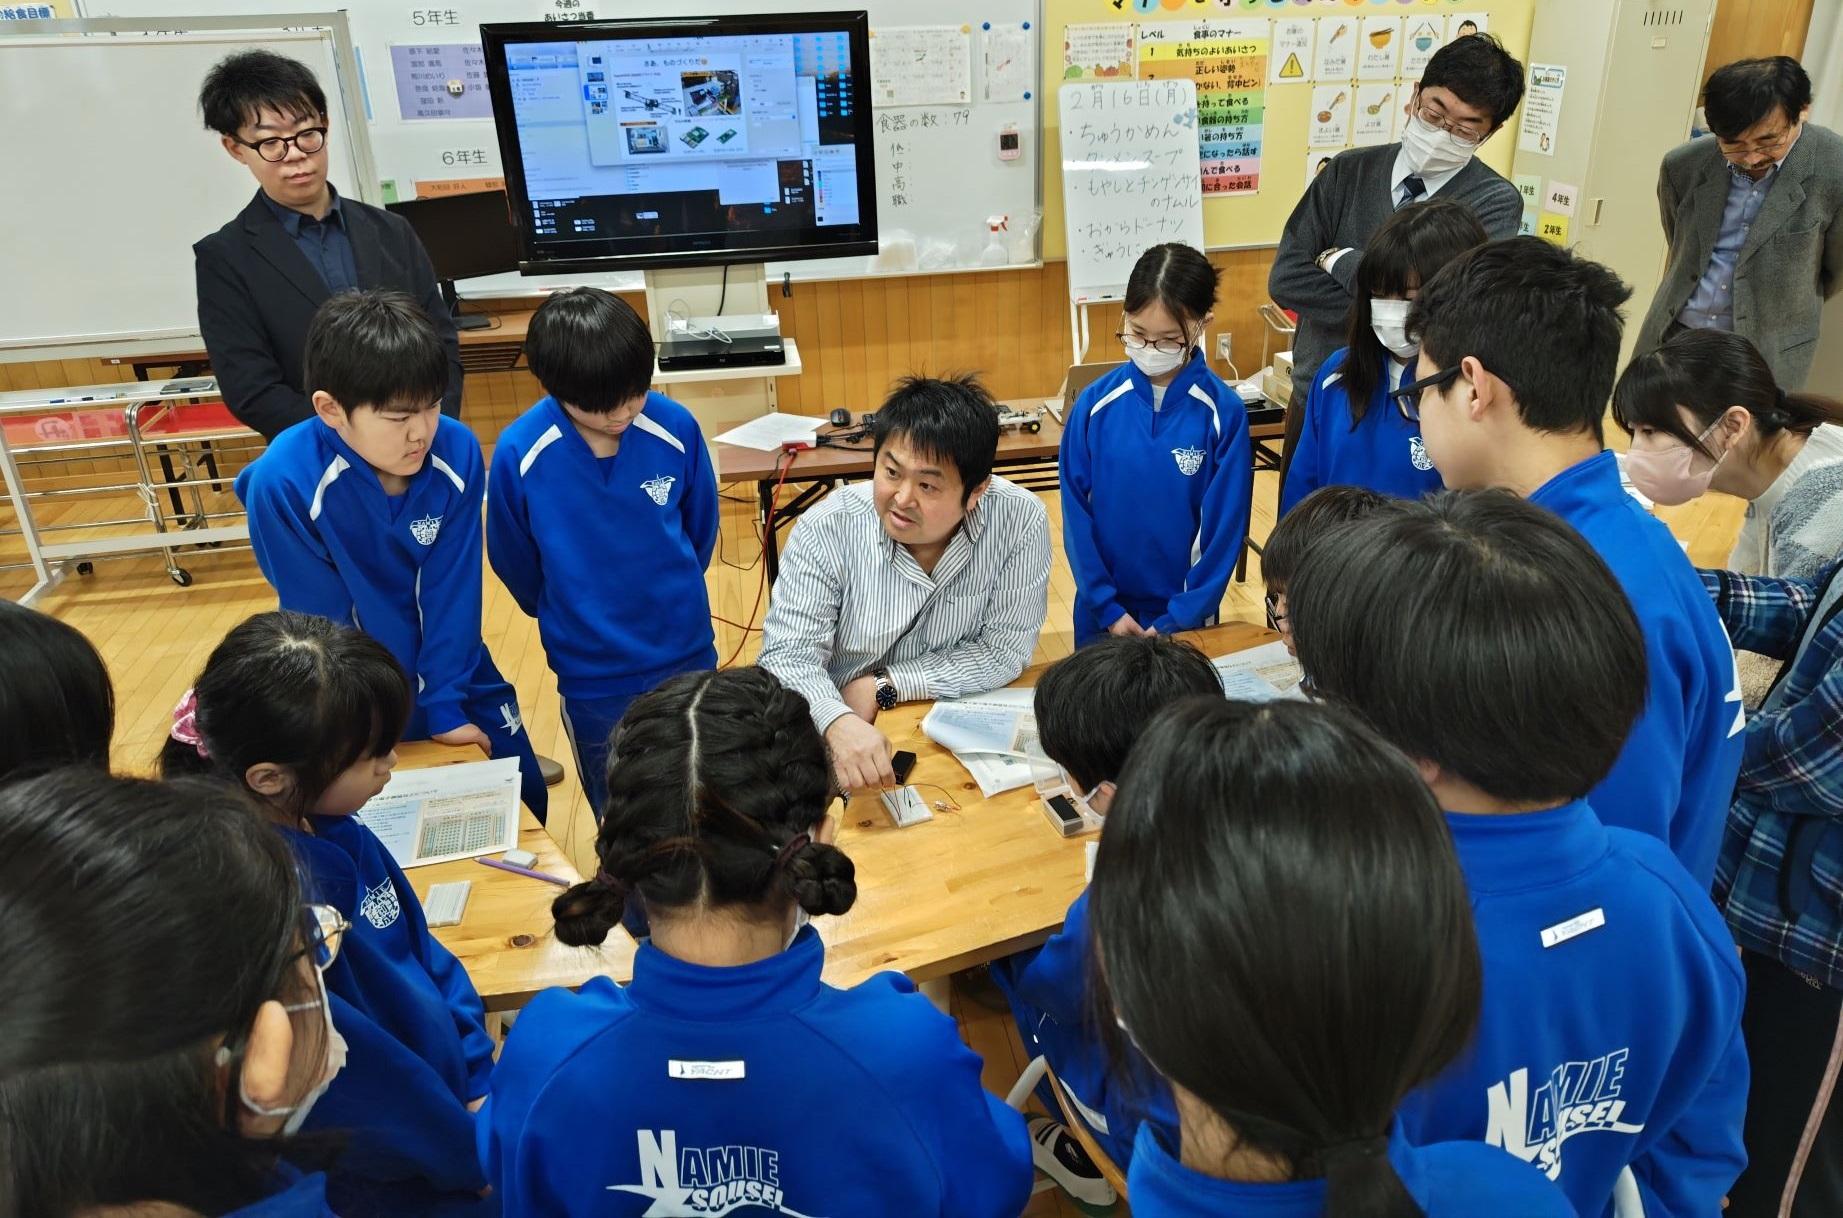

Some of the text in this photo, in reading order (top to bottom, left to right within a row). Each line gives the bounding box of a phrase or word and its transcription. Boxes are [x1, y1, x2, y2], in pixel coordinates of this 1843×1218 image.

[412, 9, 460, 26] 5年生
[1141, 28, 1242, 39] レベル 食事のマナー
[1176, 45, 1257, 57] 気持ちのよいあいさつ
[1195, 64, 1236, 75] 正しい姿勢
[442, 149, 488, 165] 6年生
[1551, 192, 1570, 207] 4年生
[1543, 224, 1562, 236] 2年生
[637, 1129, 779, 1189] NAMIE
